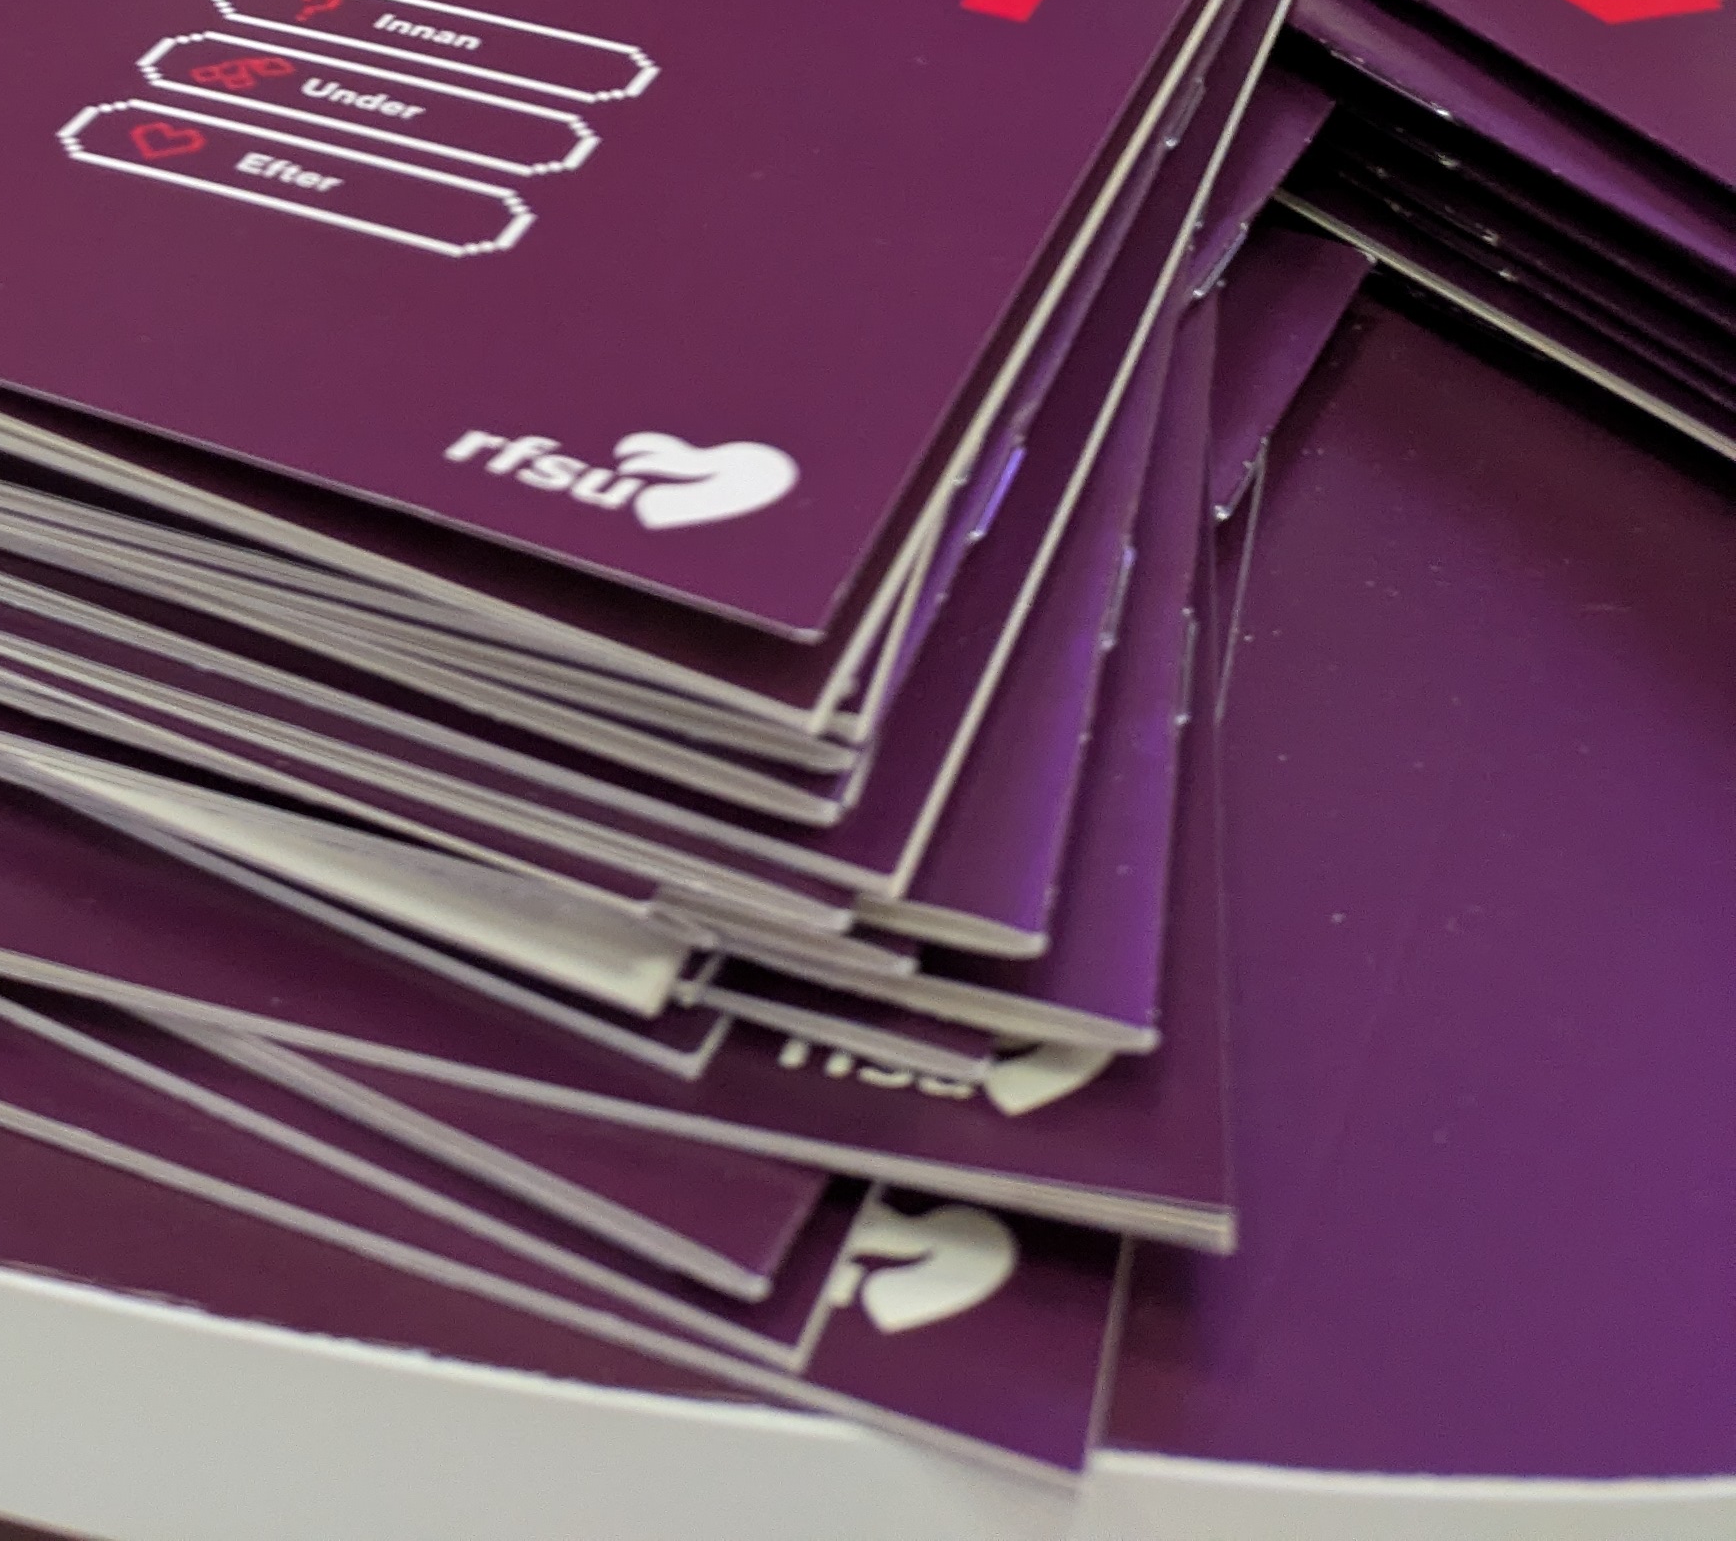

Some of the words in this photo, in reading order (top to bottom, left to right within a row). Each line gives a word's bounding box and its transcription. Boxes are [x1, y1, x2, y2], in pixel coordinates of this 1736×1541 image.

[373, 12, 482, 52] Innan
[300, 76, 426, 124] Under
[235, 150, 343, 195] Efter
[445, 429, 648, 513] rfsu
